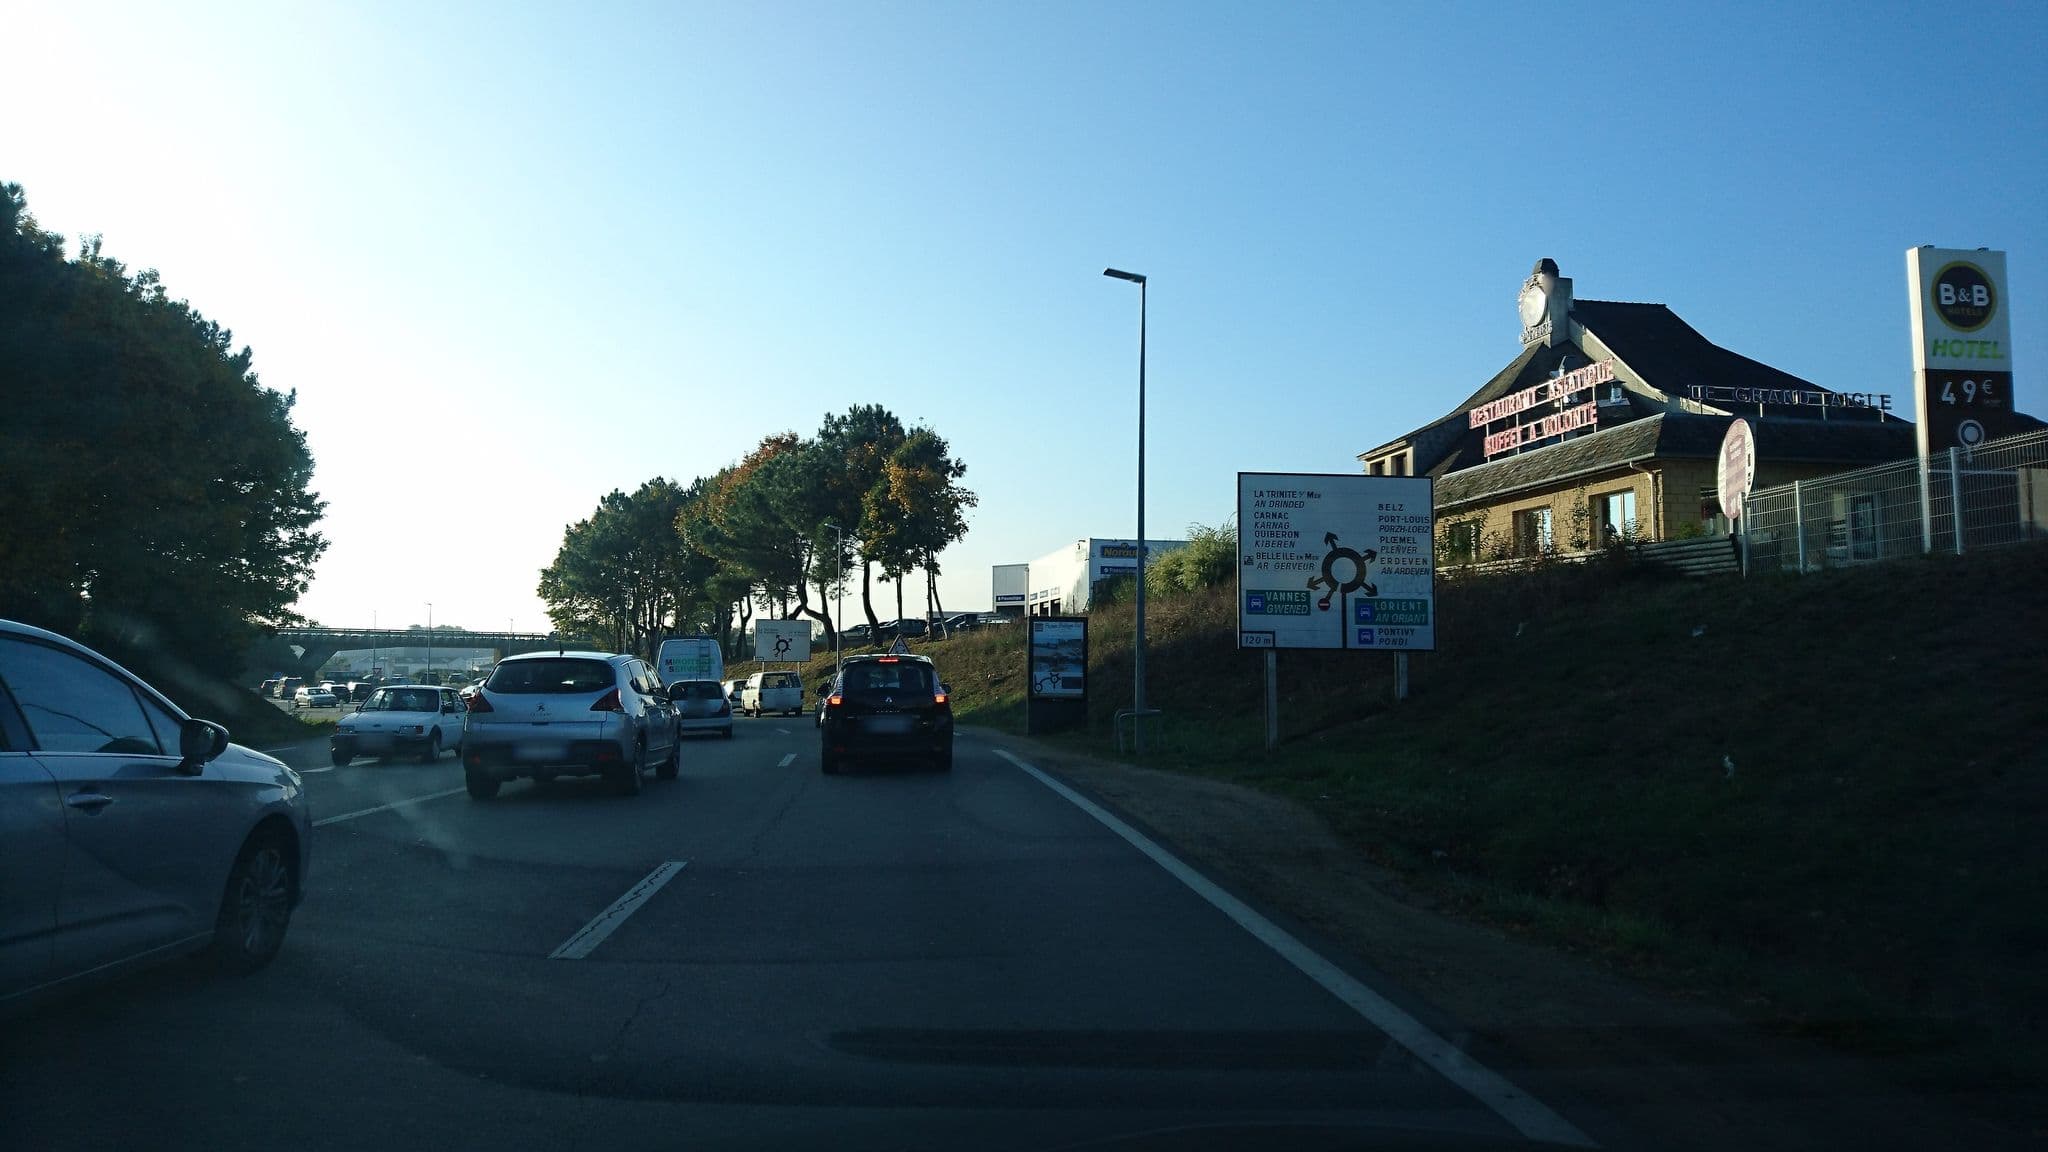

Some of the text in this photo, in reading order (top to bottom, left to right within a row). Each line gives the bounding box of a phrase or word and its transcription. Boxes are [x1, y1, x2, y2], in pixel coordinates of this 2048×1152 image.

[1939, 283, 1990, 307] B&B
[1932, 339, 2004, 359] HOTEL
[1470, 358, 1615, 429] RESTAURANT ASIATIQUE
[1734, 387, 1810, 405] GRAND
[1831, 393, 1893, 410] AIGLE
[1484, 427, 1523, 457] BUFFET
[1254, 490, 1264, 498] LA
[1266, 490, 1297, 498] TRINITE
[1254, 500, 1305, 509] AN DRINDED
[1378, 503, 1404, 511] BELZ
[1254, 511, 1289, 519] CARNAC
[1378, 515, 1430, 524] PORT-LOUIS
[1254, 521, 1290, 530] KARNAG
[1254, 530, 1300, 538] QUIBERON
[1254, 540, 1296, 548] KIBEREN
[1380, 557, 1428, 566] ERDEVEN
[1256, 562, 1315, 571] AR GERVEUR
[1394, 568, 1430, 576] ARDEVEN
[1265, 591, 1307, 602] VANNES
[1266, 604, 1309, 615] GWENED
[1374, 601, 1423, 611] LORIENT
[1375, 613, 1427, 624] AN ORIANT
[1378, 627, 1415, 636] PONTIVY
[1245, 635, 1271, 645] 120 m
[1378, 637, 1408, 646] PONDI
